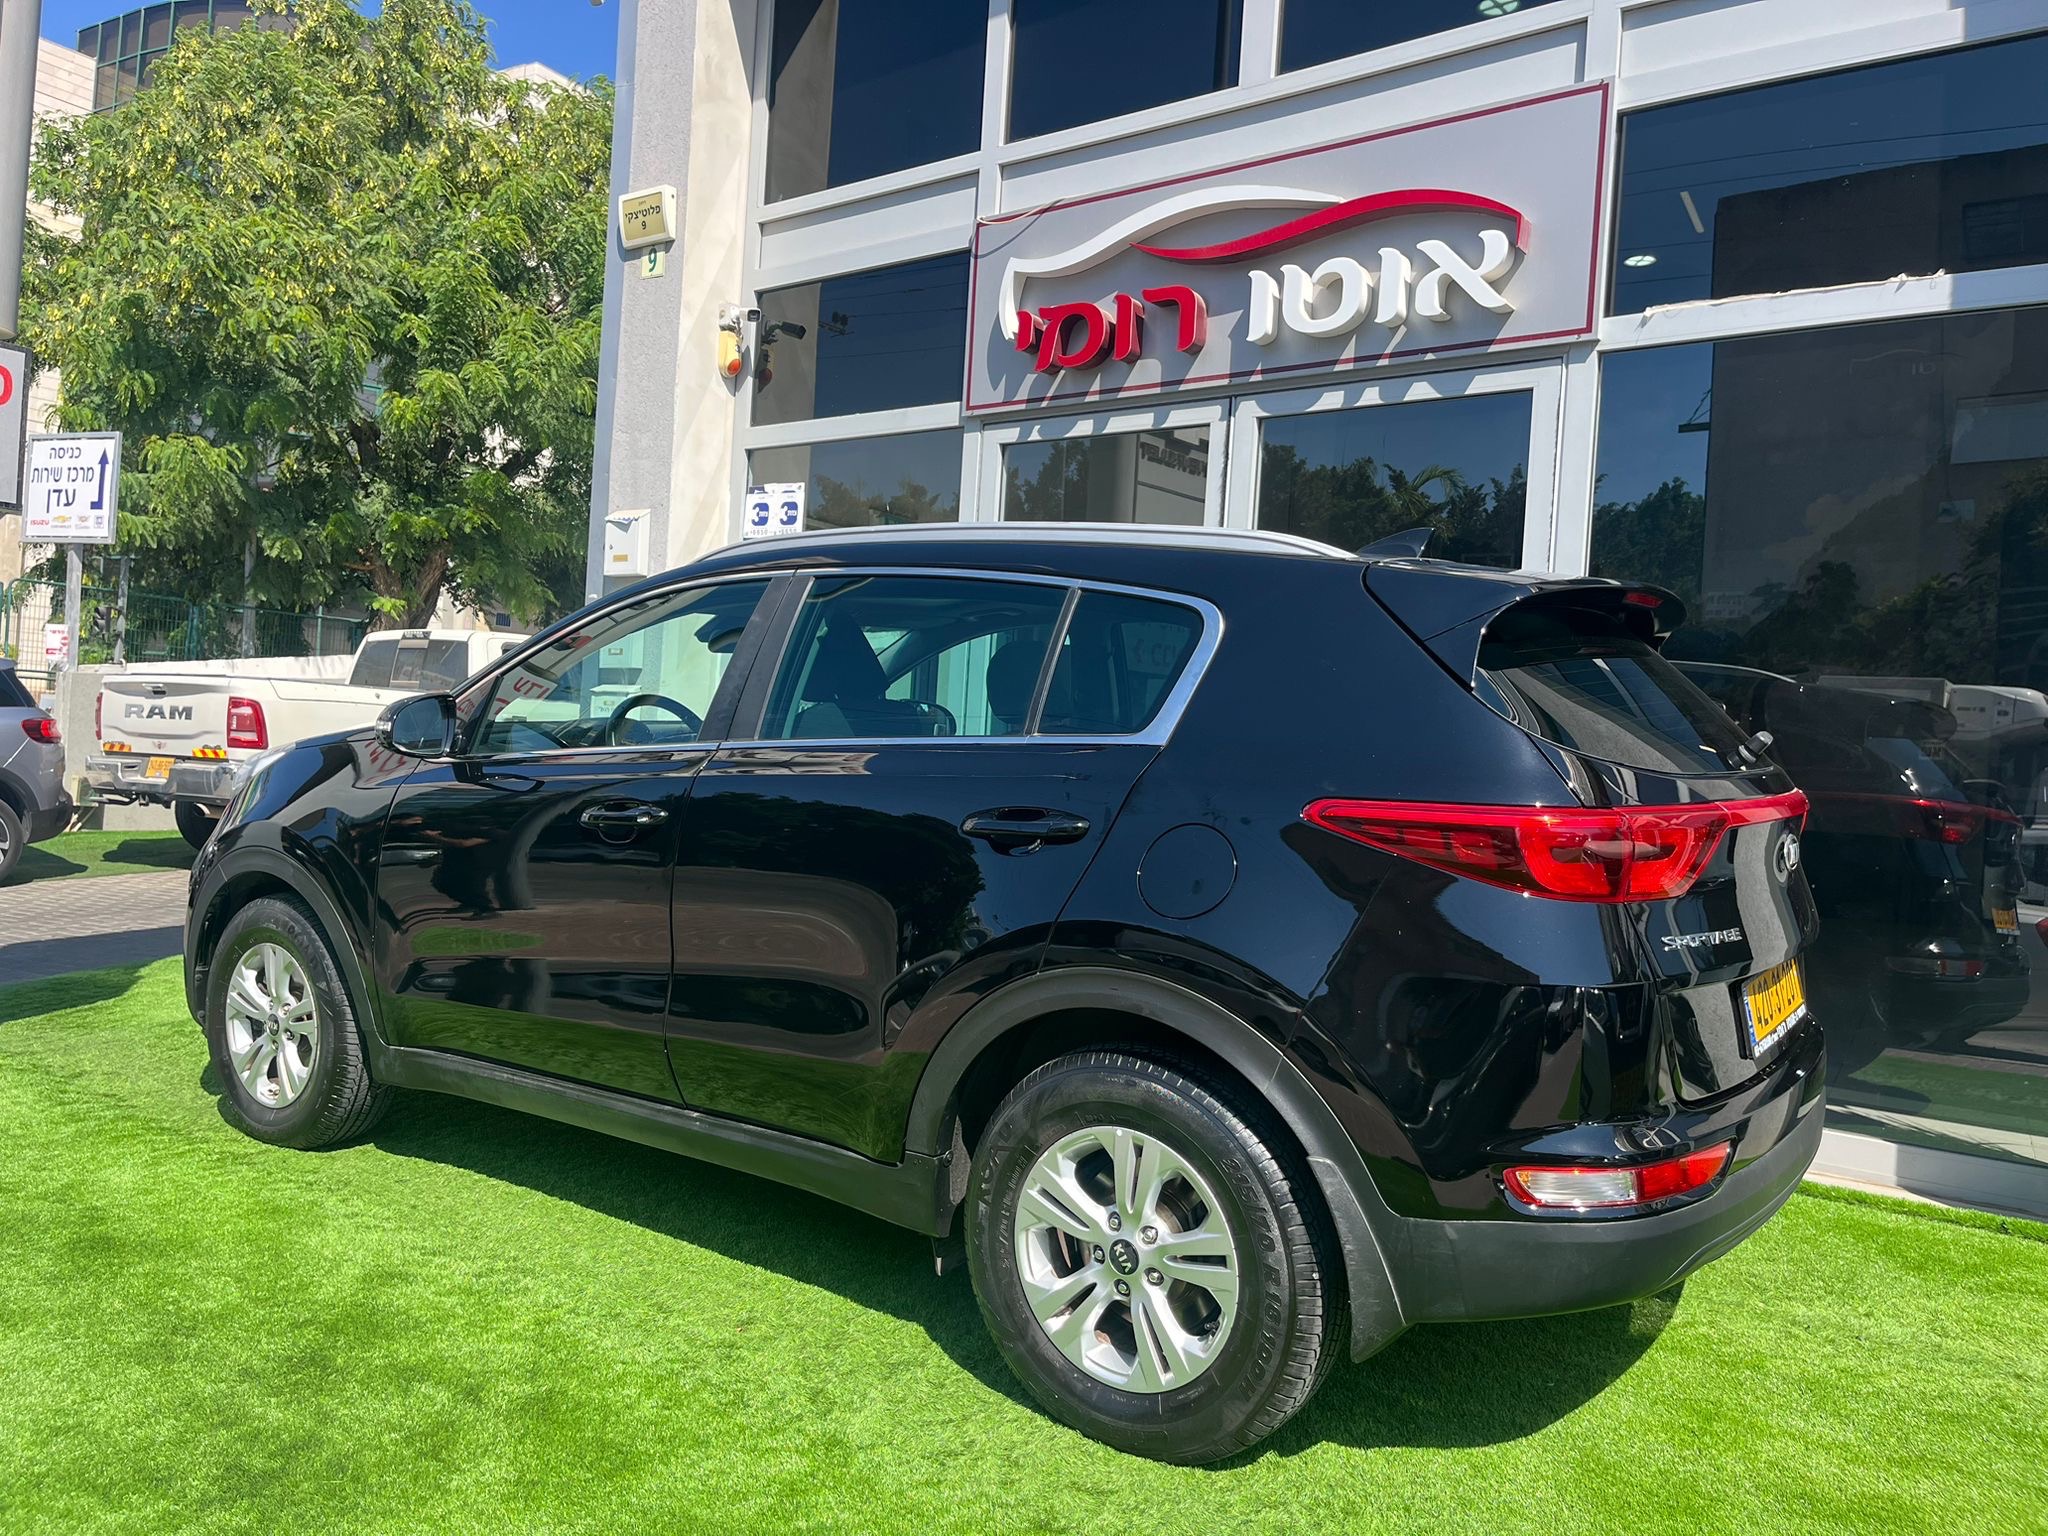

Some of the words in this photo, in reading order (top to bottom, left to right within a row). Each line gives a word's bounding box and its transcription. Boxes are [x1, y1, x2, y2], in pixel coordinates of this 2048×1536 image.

[625, 205, 661, 224] פלוטיצקי
[641, 220, 647, 230] 9
[648, 246, 658, 272] 9
[1246, 229, 1515, 346] אוטו
[1015, 284, 1208, 375] רומי
[49, 446, 82, 460] כניסה
[31, 466, 63, 484] שירות
[67, 466, 95, 483] מרכז
[46, 488, 76, 514] עדן
[30, 518, 50, 526] ISUZU
[124, 703, 193, 721] RAM
[1113, 1242, 1132, 1273] KIA
